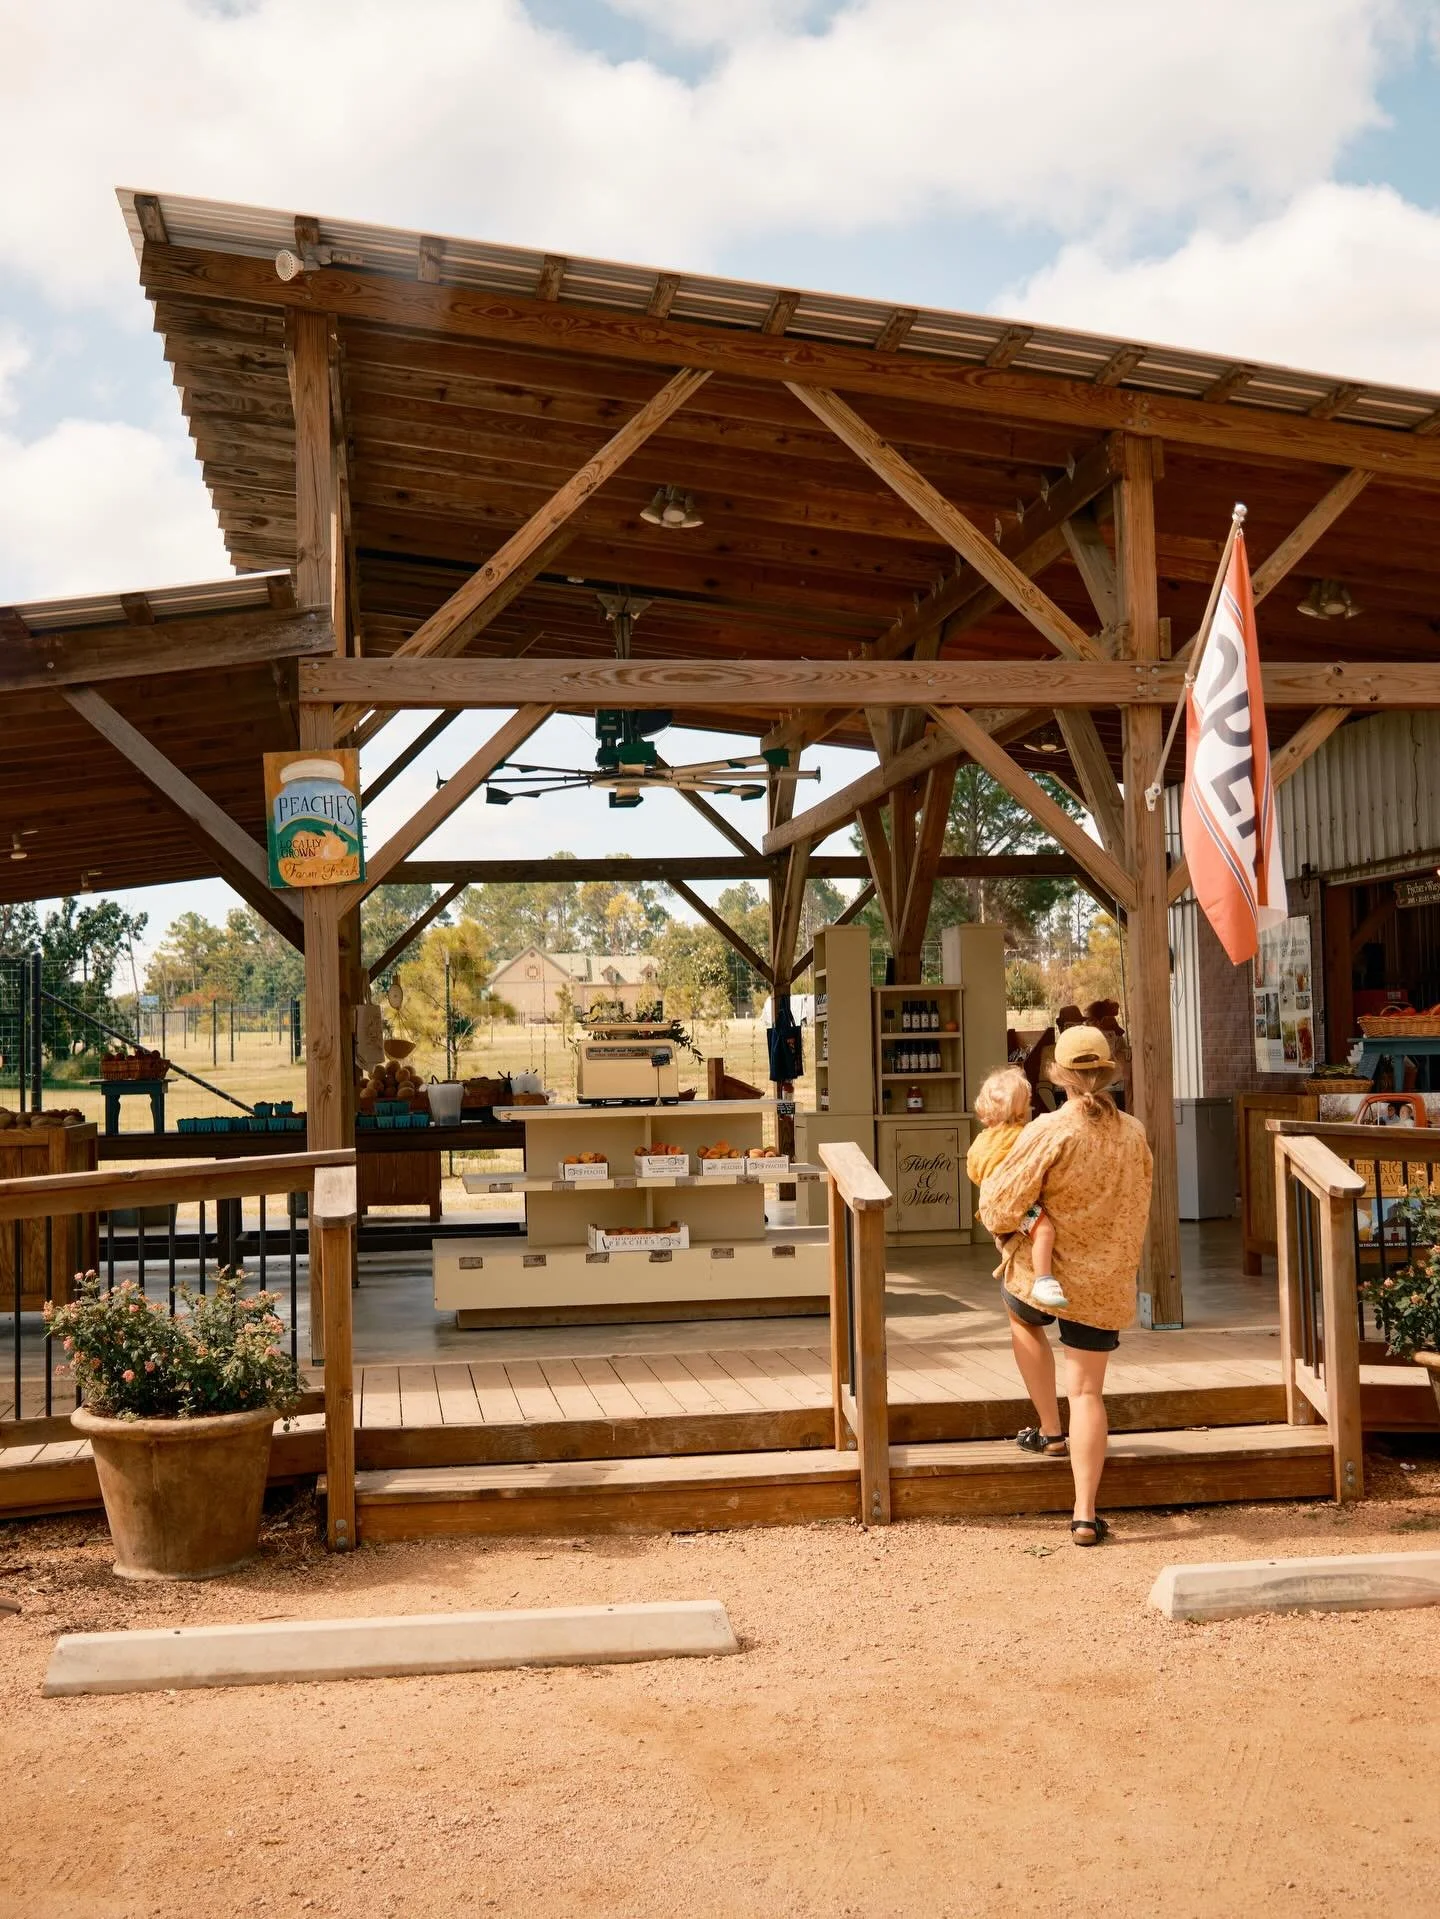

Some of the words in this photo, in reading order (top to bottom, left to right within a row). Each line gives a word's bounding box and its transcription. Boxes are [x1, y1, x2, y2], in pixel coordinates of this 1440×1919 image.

[278, 794, 356, 826] PEACHES
[280, 839, 322, 849] LOCALLY
[280, 848, 316, 858] GROWN
[283, 861, 318, 878] Farm
[321, 856, 359, 881] Fresh
[899, 1153, 953, 1173] Fischer
[902, 1189, 953, 1206] Wieser
[609, 1239, 656, 1247] PEACHES
